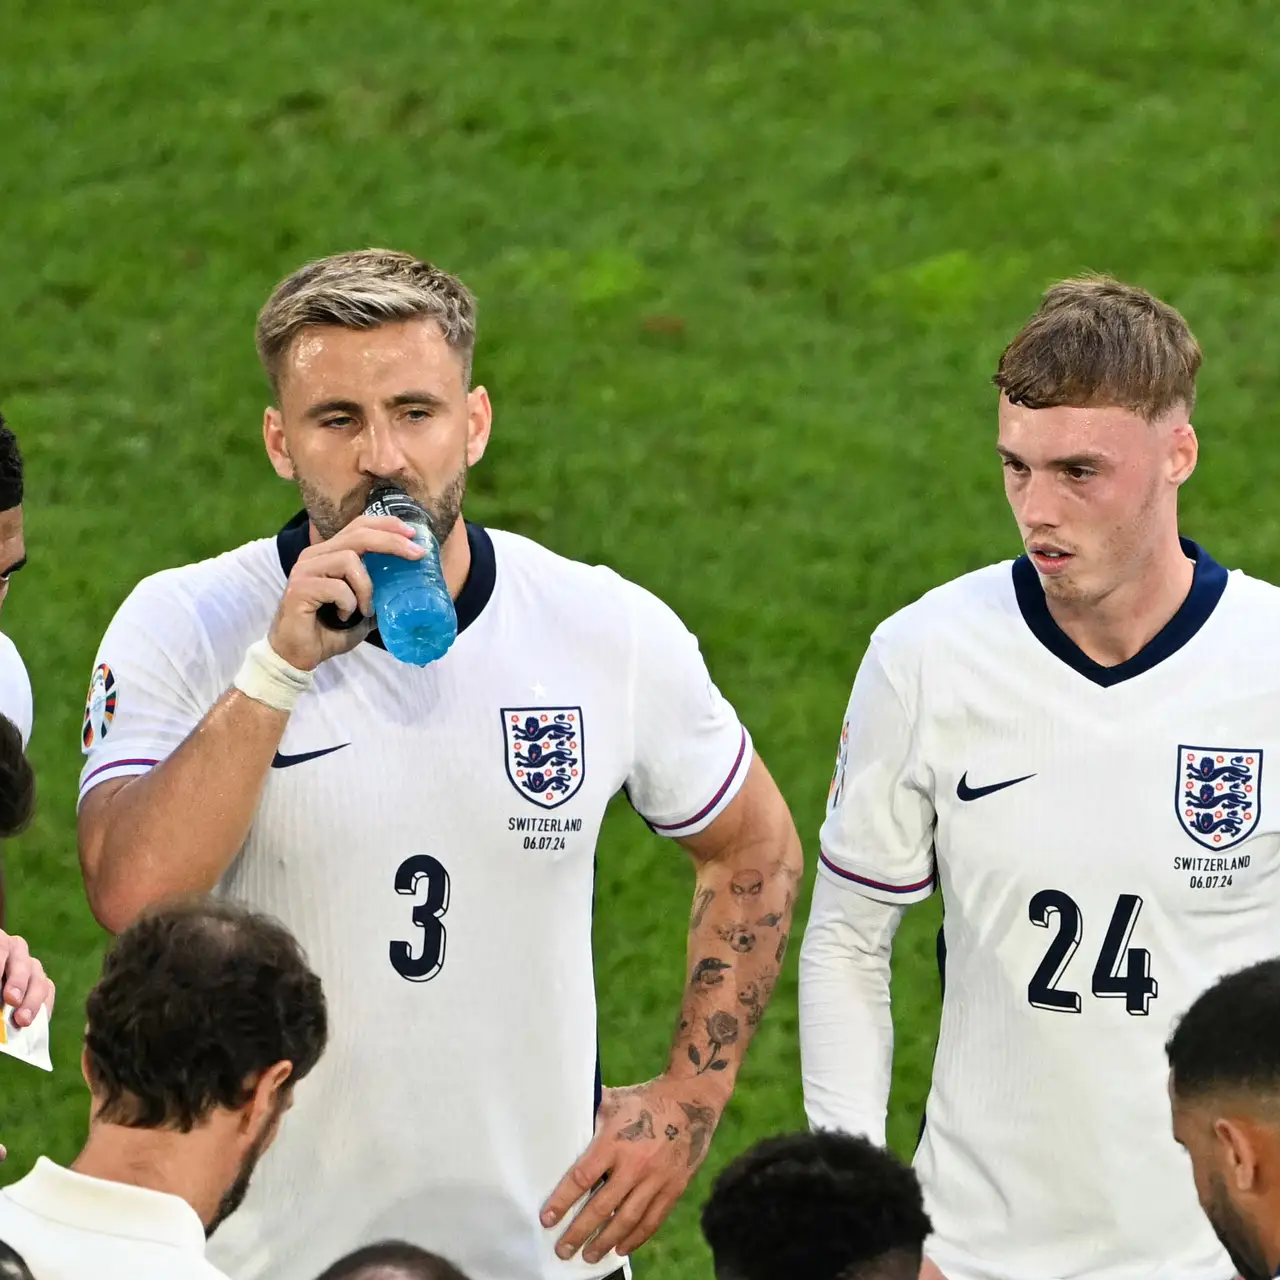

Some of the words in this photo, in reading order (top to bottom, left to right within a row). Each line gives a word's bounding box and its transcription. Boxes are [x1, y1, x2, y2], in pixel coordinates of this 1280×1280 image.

[508, 817, 582, 832] SWITZERLAND
[523, 836, 565, 851] 06.07.24
[1173, 855, 1251, 872] SWITZERLAND
[1189, 874, 1233, 889] 06.07.24
[389, 854, 451, 983] 3
[1027, 889, 1158, 1017] 24
